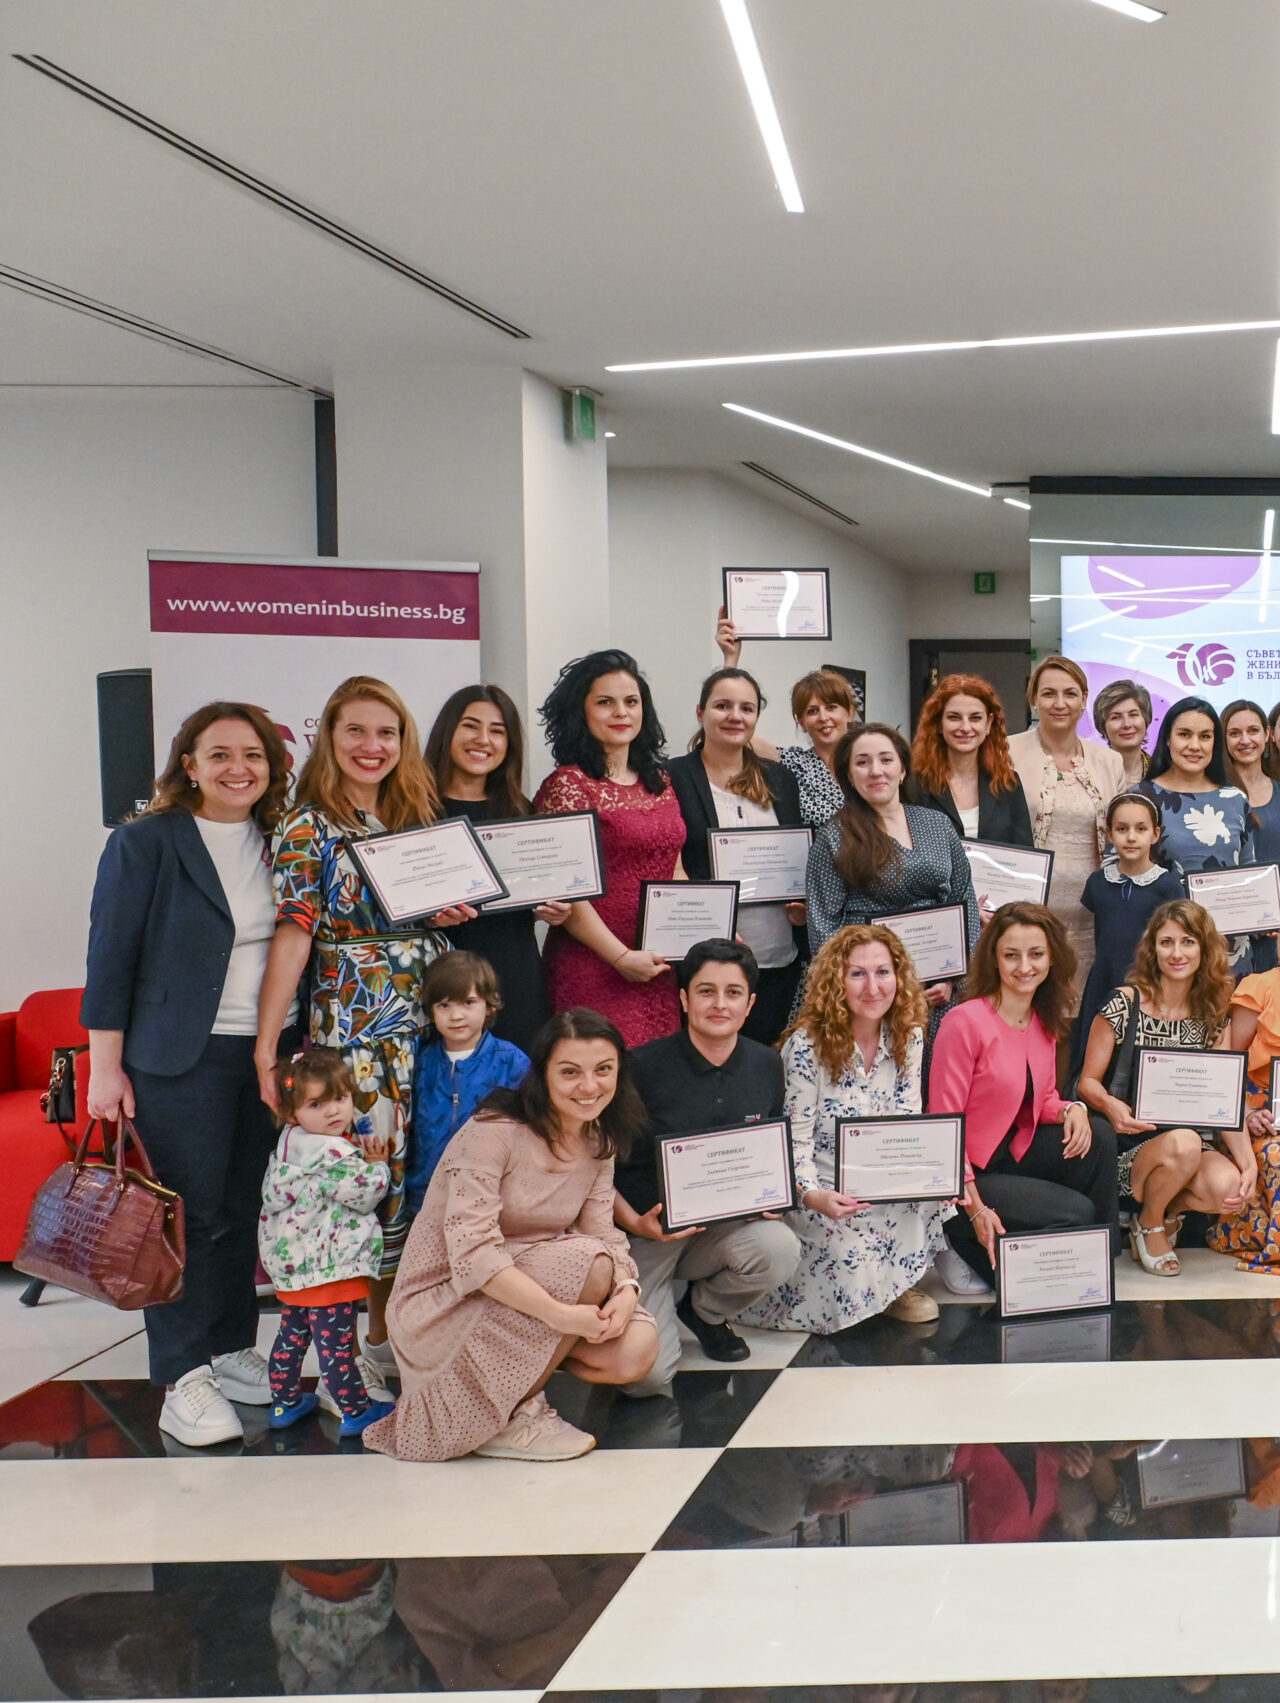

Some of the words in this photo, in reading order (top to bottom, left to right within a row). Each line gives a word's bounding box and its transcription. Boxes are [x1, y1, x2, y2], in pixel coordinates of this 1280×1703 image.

[167, 598, 466, 624] www.womeninbusiness.bg
[1246, 671, 1254, 680] В
[516, 837, 555, 846] СЕРТИФИКАТ
[882, 1137, 920, 1145] СЕРТИФИКАТ
[707, 1147, 746, 1159] СЕРТИФИКАТ
